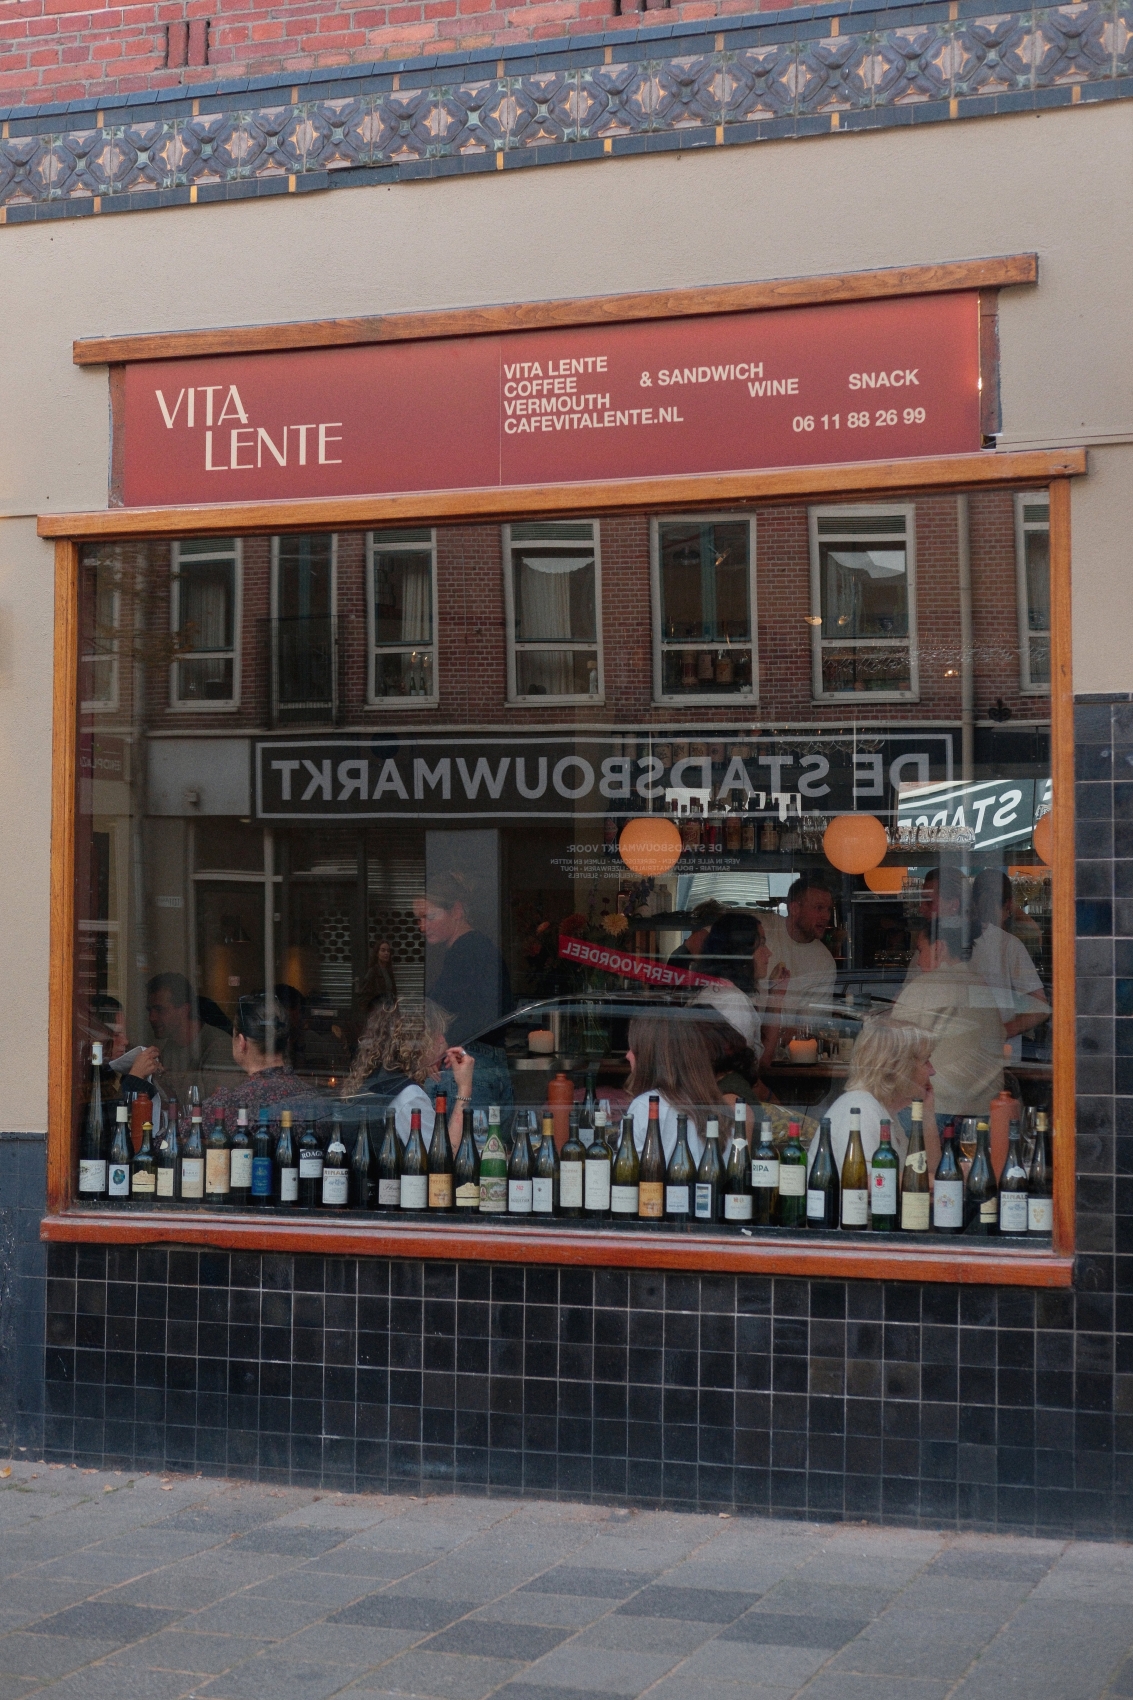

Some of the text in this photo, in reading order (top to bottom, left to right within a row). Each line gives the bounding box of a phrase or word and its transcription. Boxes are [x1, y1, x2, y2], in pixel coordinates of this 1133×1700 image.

[504, 356, 608, 380] VITA LENTE
[504, 362, 764, 398] COFFEE & SANDWICH
[155, 385, 249, 428] VITA
[504, 369, 920, 416] VERMOUTH WINE SNACK
[504, 406, 684, 434] CAFEVITALENTE.NL
[792, 407, 926, 433] 06 11 88 26 99
[204, 422, 343, 471] LENTE
